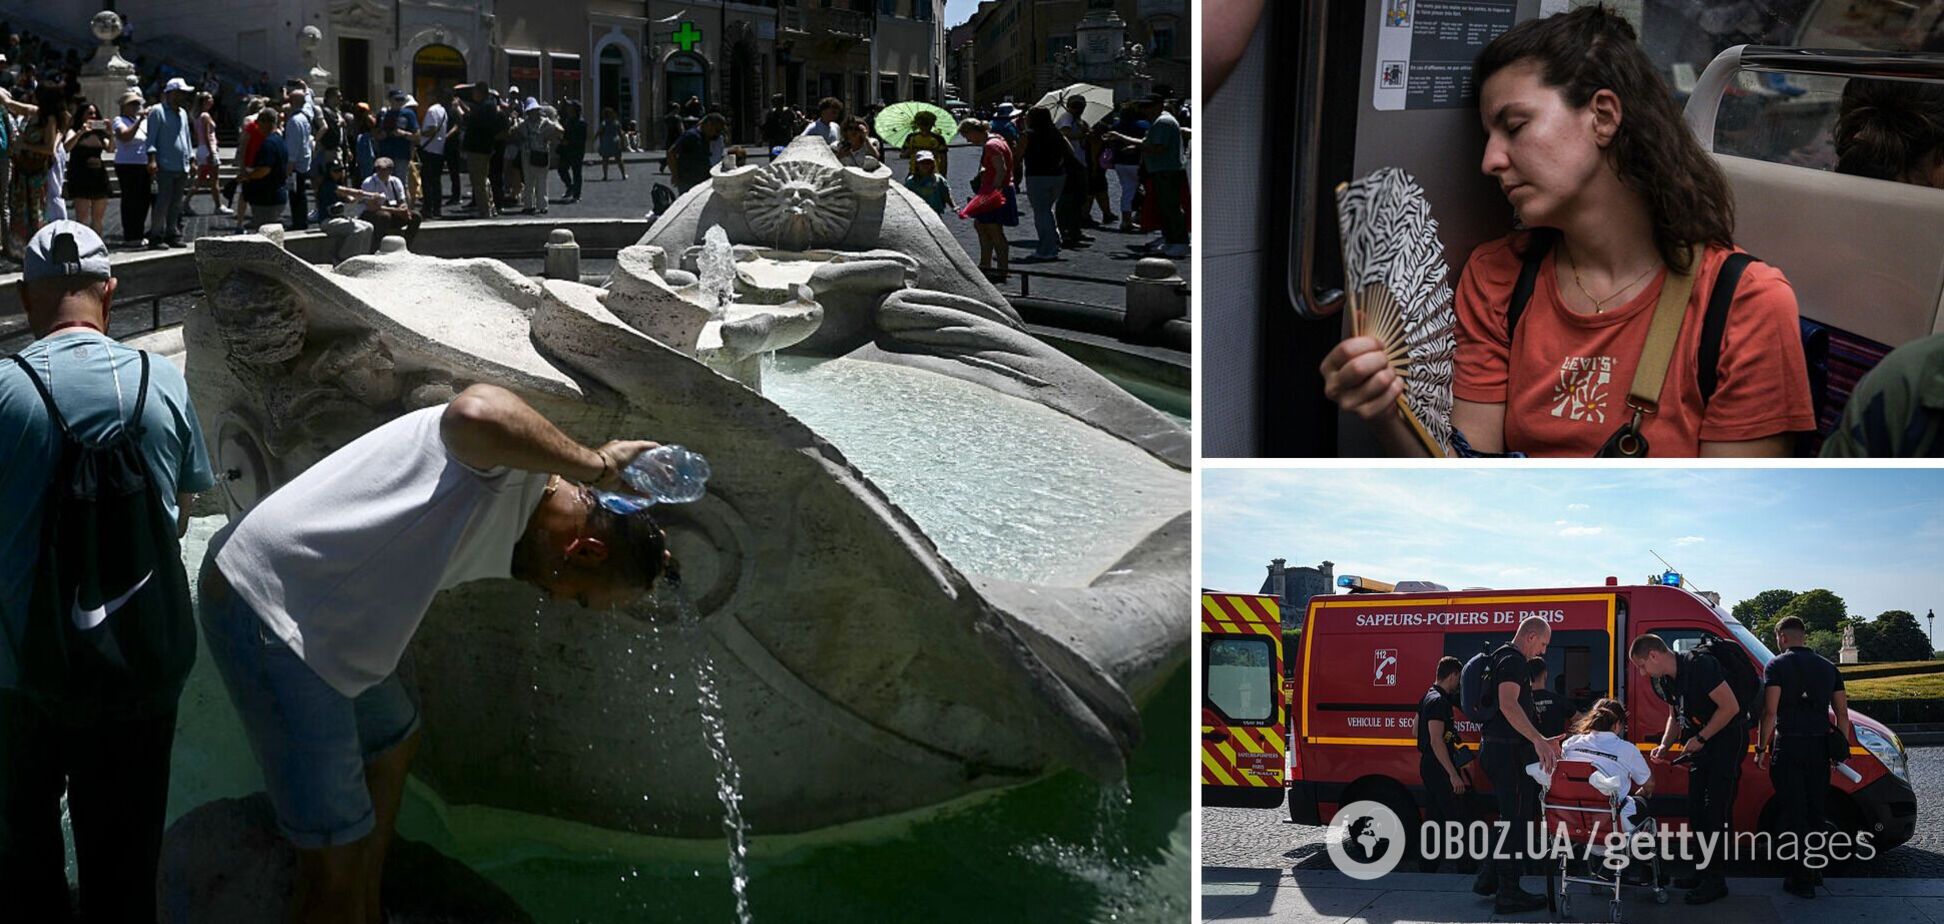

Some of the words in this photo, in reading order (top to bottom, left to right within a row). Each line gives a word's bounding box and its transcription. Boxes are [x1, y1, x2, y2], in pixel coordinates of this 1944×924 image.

[1561, 356, 1611, 371] LEVI'S
[1493, 611, 1514, 625] DE
[1376, 650, 1386, 659] 112
[1386, 674, 1395, 685] 18
[1347, 717, 1381, 728] VEHICULE
[1385, 717, 1395, 728] DE
